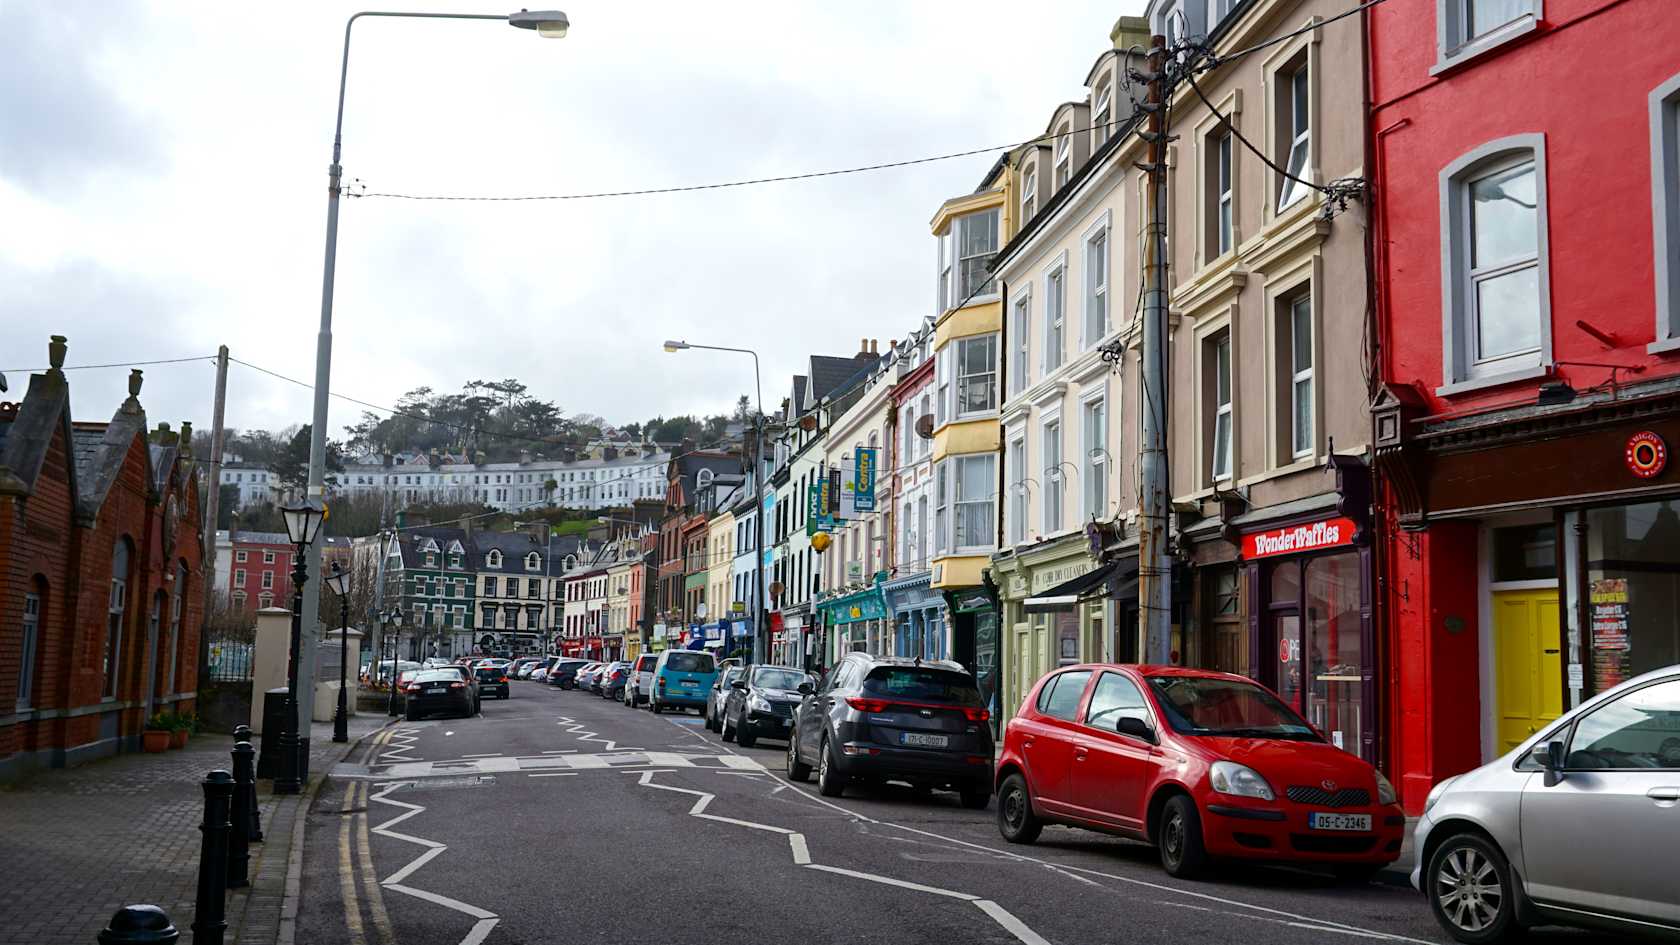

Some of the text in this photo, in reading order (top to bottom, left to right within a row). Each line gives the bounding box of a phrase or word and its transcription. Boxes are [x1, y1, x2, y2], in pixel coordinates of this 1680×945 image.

[858, 453, 869, 493] Centra
[819, 483, 828, 516] Centra
[1255, 522, 1339, 555] WonderWaffles
[1319, 816, 1367, 829] 05-C-2346
